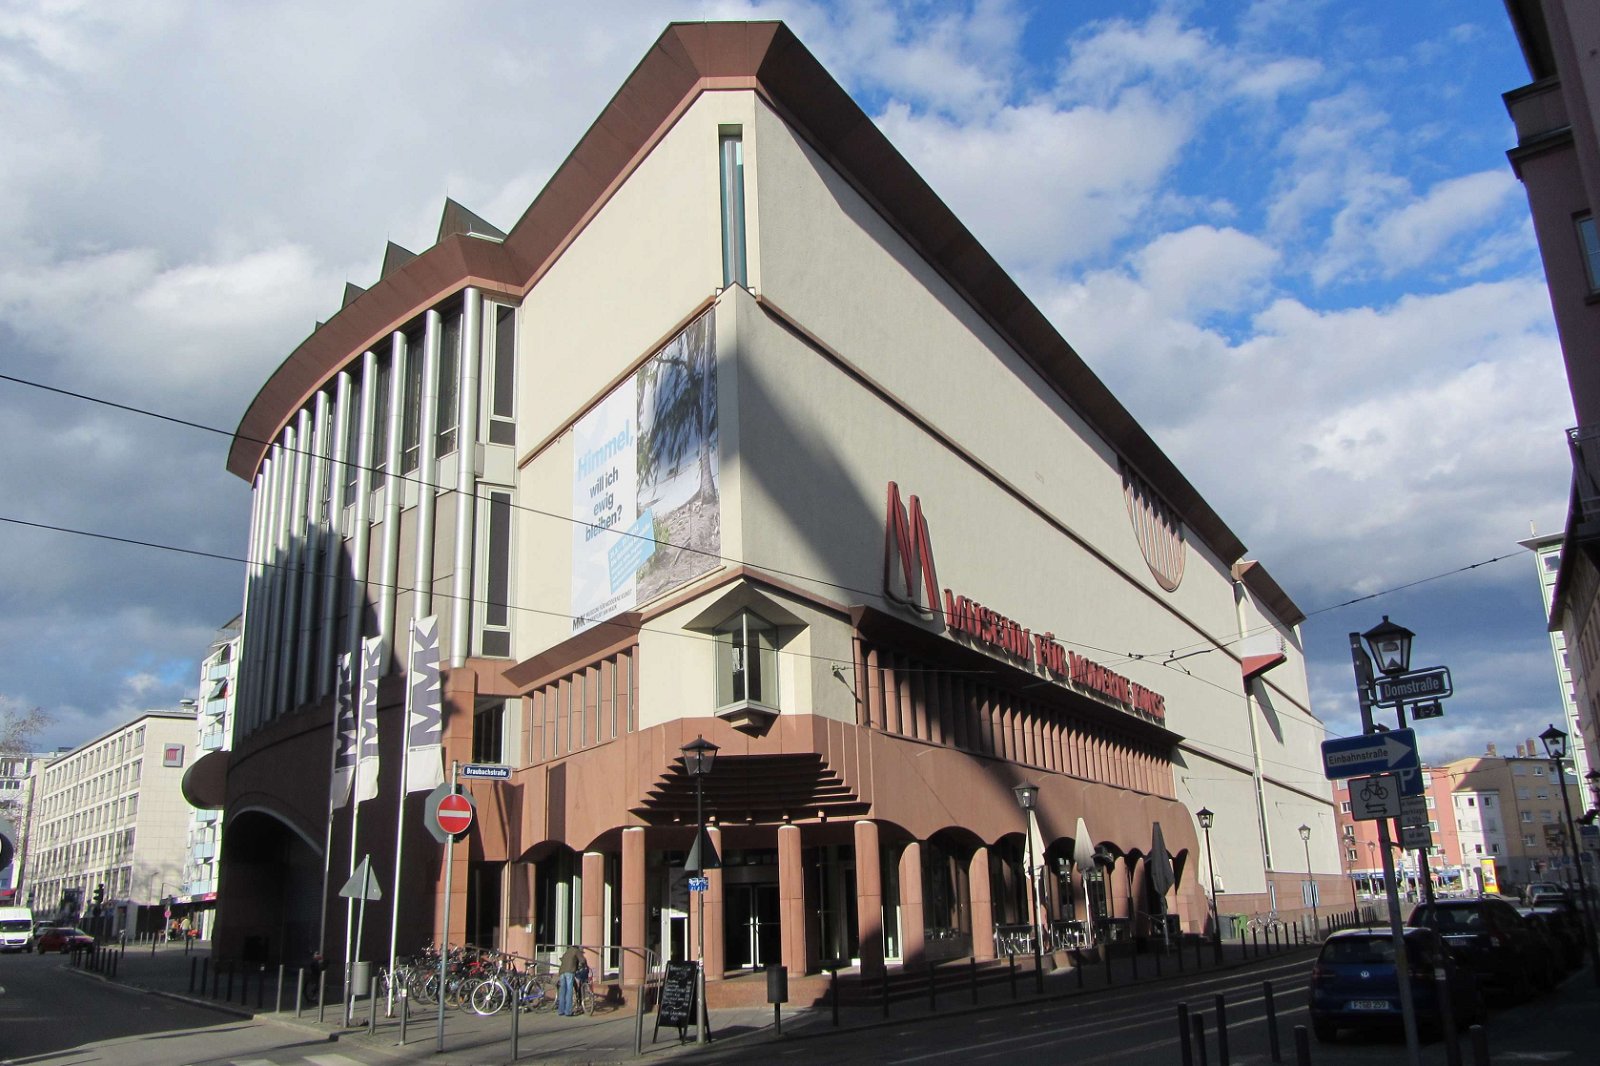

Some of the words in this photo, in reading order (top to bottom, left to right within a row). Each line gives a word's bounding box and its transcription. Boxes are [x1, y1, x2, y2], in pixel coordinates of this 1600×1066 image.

[577, 419, 634, 481] Himmel,
[590, 474, 604, 498] will
[605, 465, 619, 488] ich
[593, 492, 614, 517] ewig
[585, 504, 623, 542] bleiben?
[1033, 631, 1069, 677] FÜR
[1384, 676, 1440, 697] Domstraße
[1328, 748, 1389, 765] Einbahnstraße
[466, 767, 507, 777] Braubachstraße
